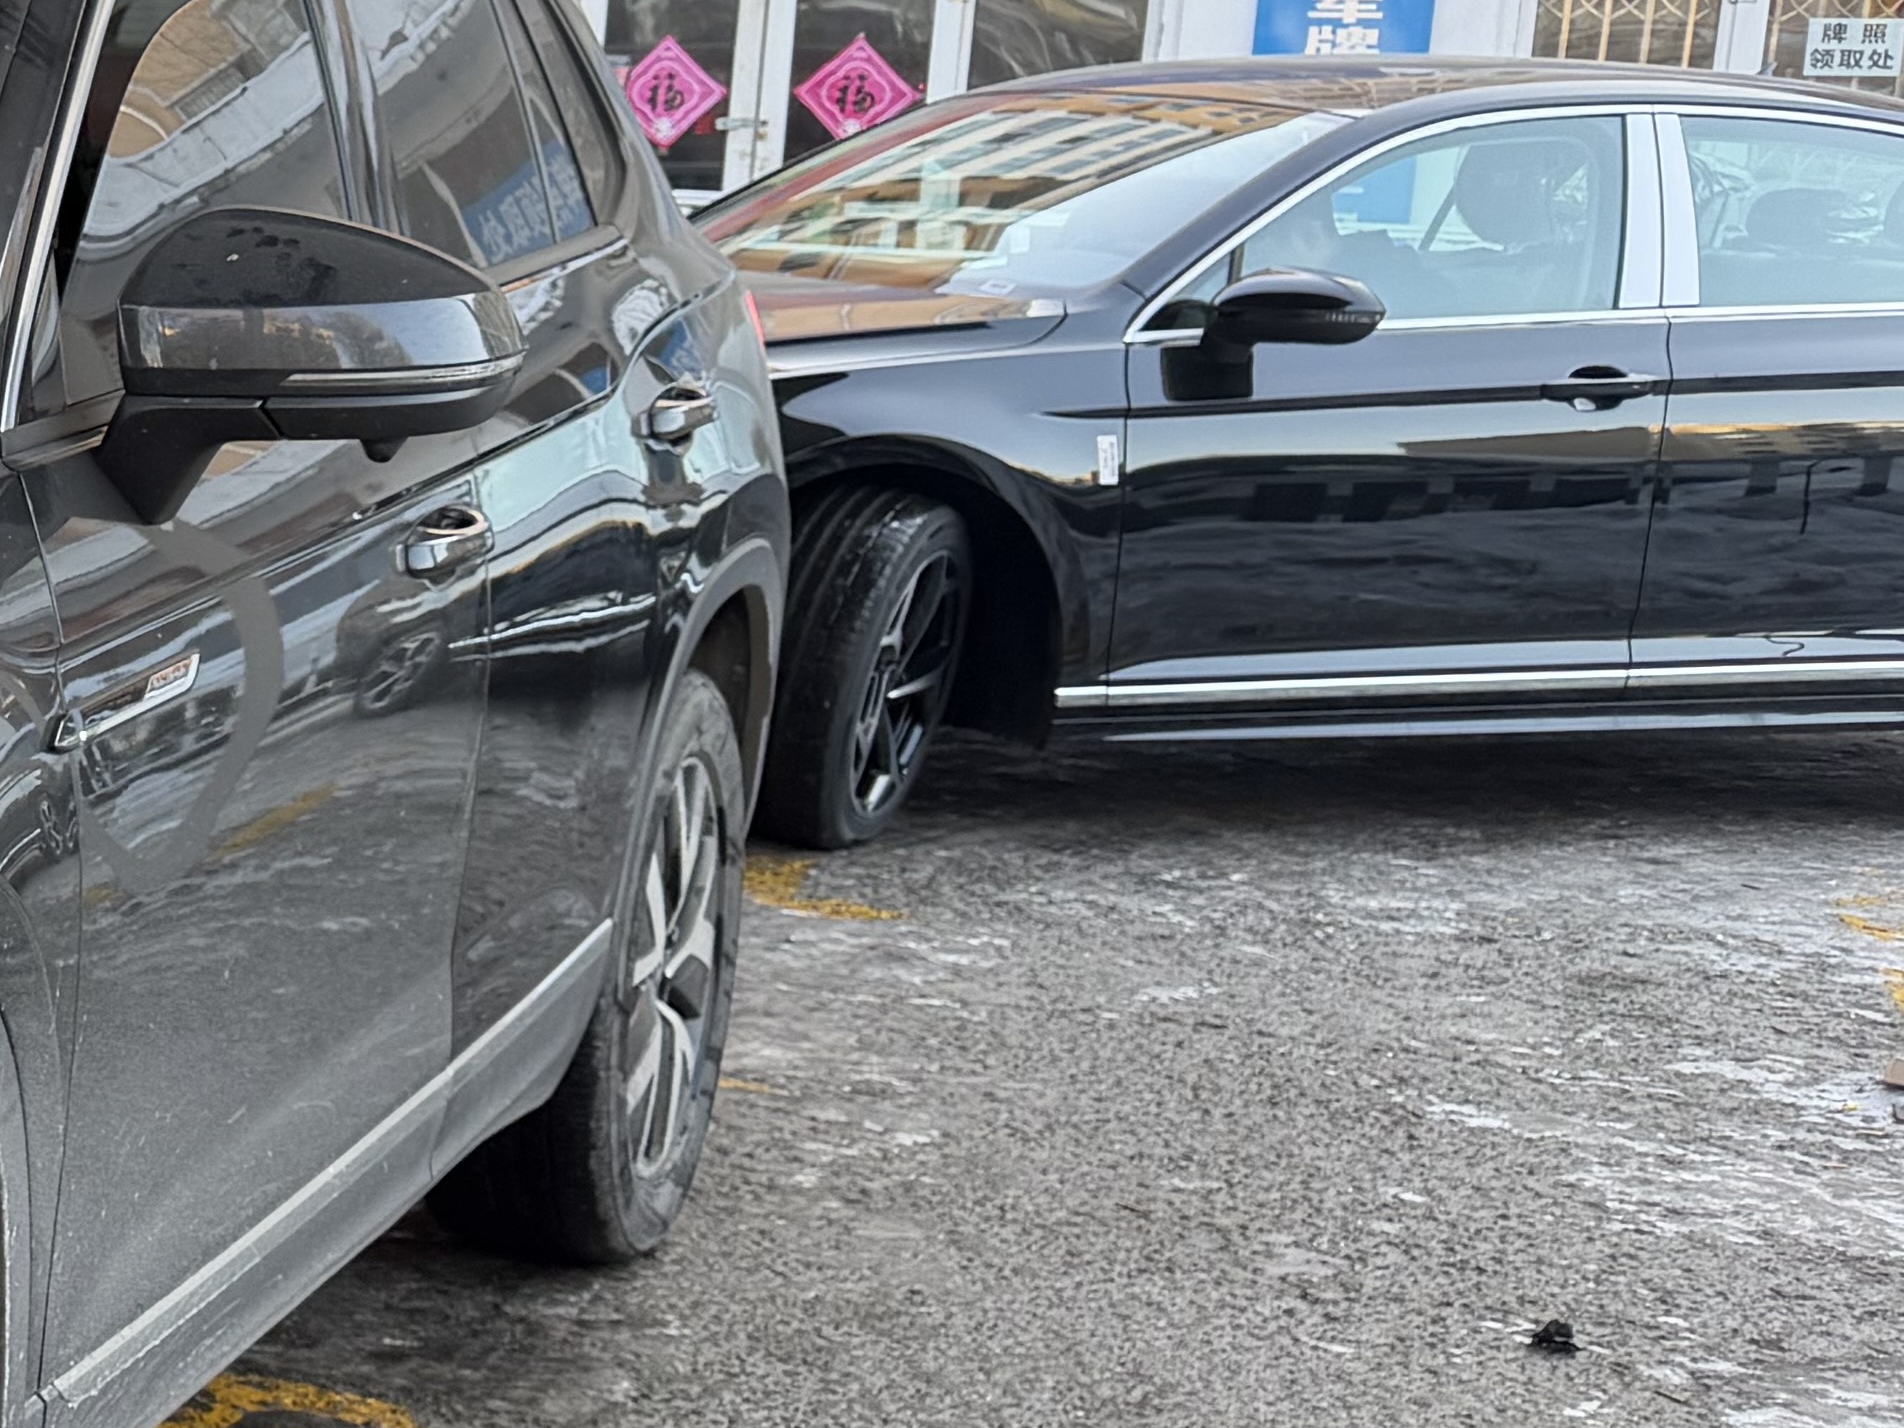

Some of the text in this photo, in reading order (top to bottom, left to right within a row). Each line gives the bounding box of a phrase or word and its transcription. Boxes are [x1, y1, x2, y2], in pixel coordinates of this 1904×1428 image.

[1821, 22, 1888, 45] 牌照
[1810, 48, 1894, 70] 领取处
[647, 72, 685, 112] 福
[835, 73, 875, 114] 福
